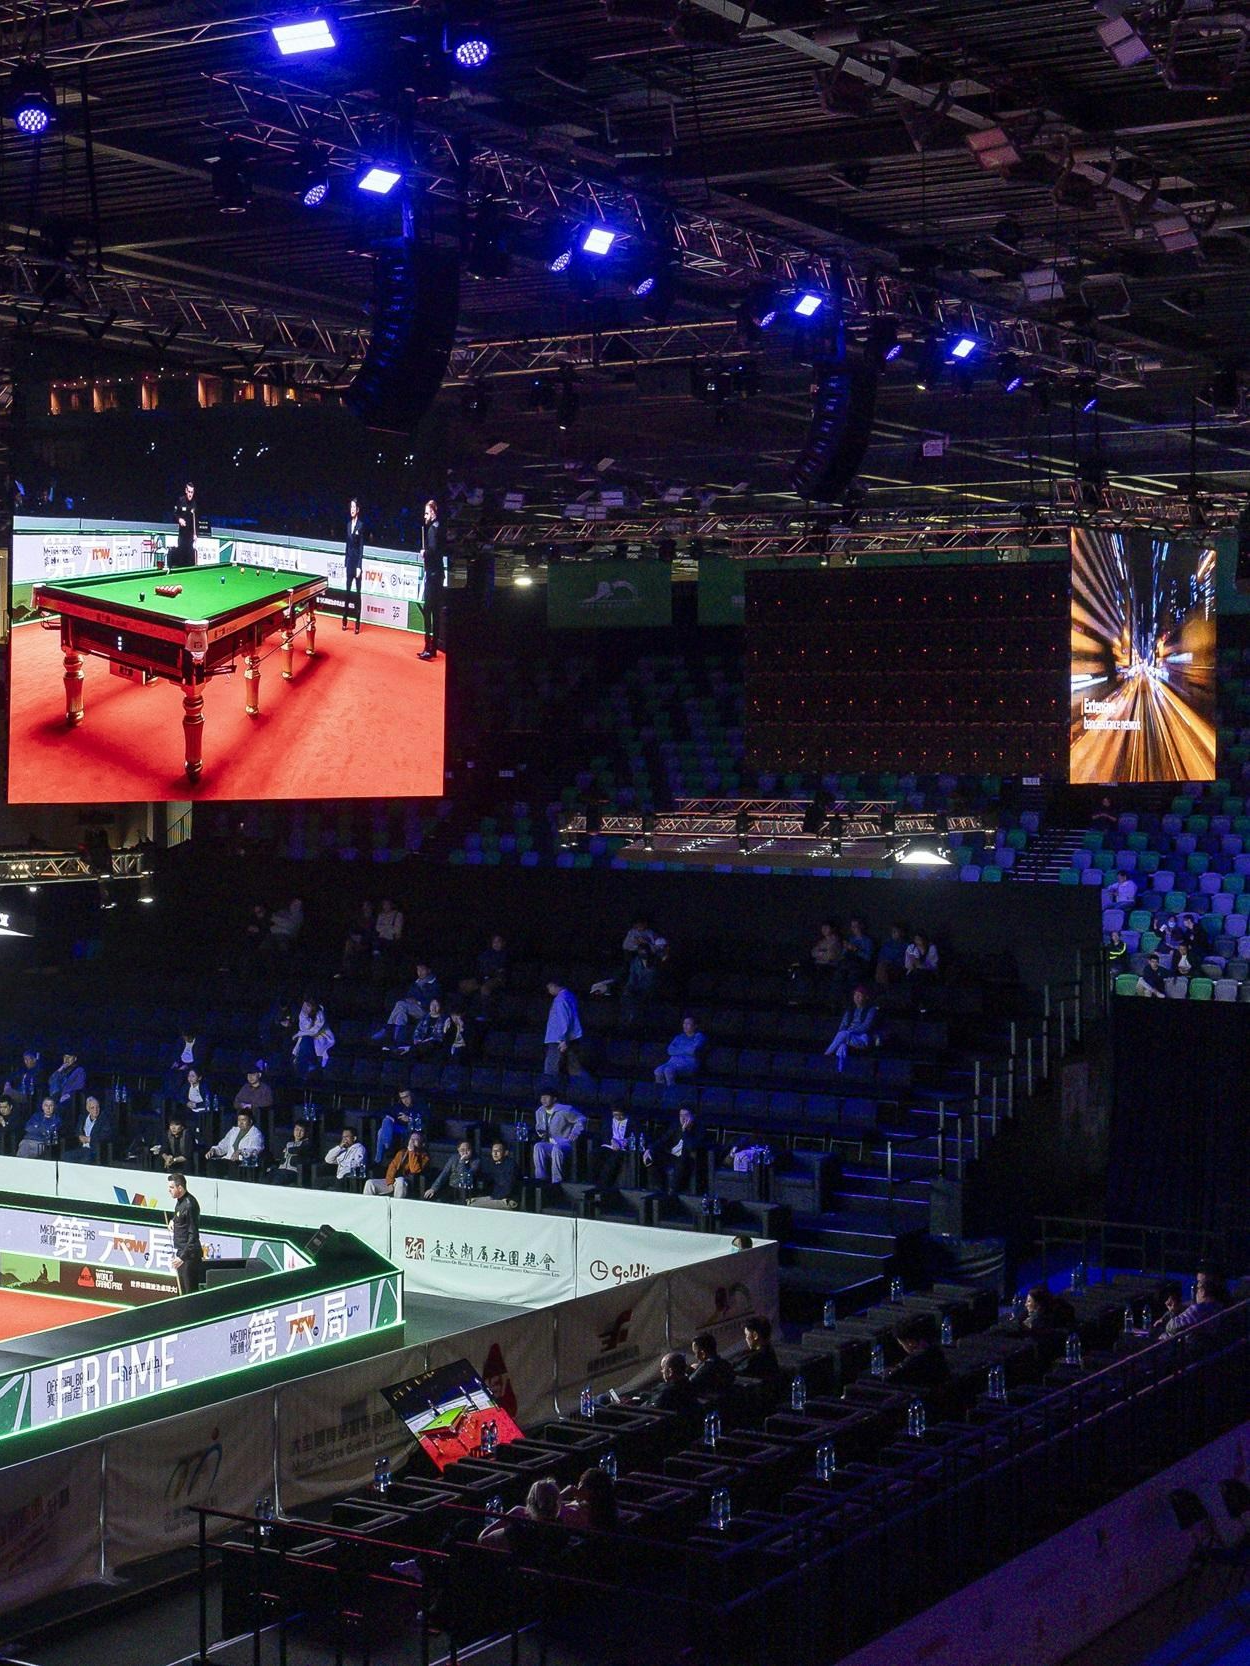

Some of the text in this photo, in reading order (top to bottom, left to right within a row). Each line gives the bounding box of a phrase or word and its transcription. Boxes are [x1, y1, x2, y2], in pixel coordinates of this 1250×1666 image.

[248, 1291, 348, 1364] 第六局
[56, 1333, 179, 1419] FRAME
